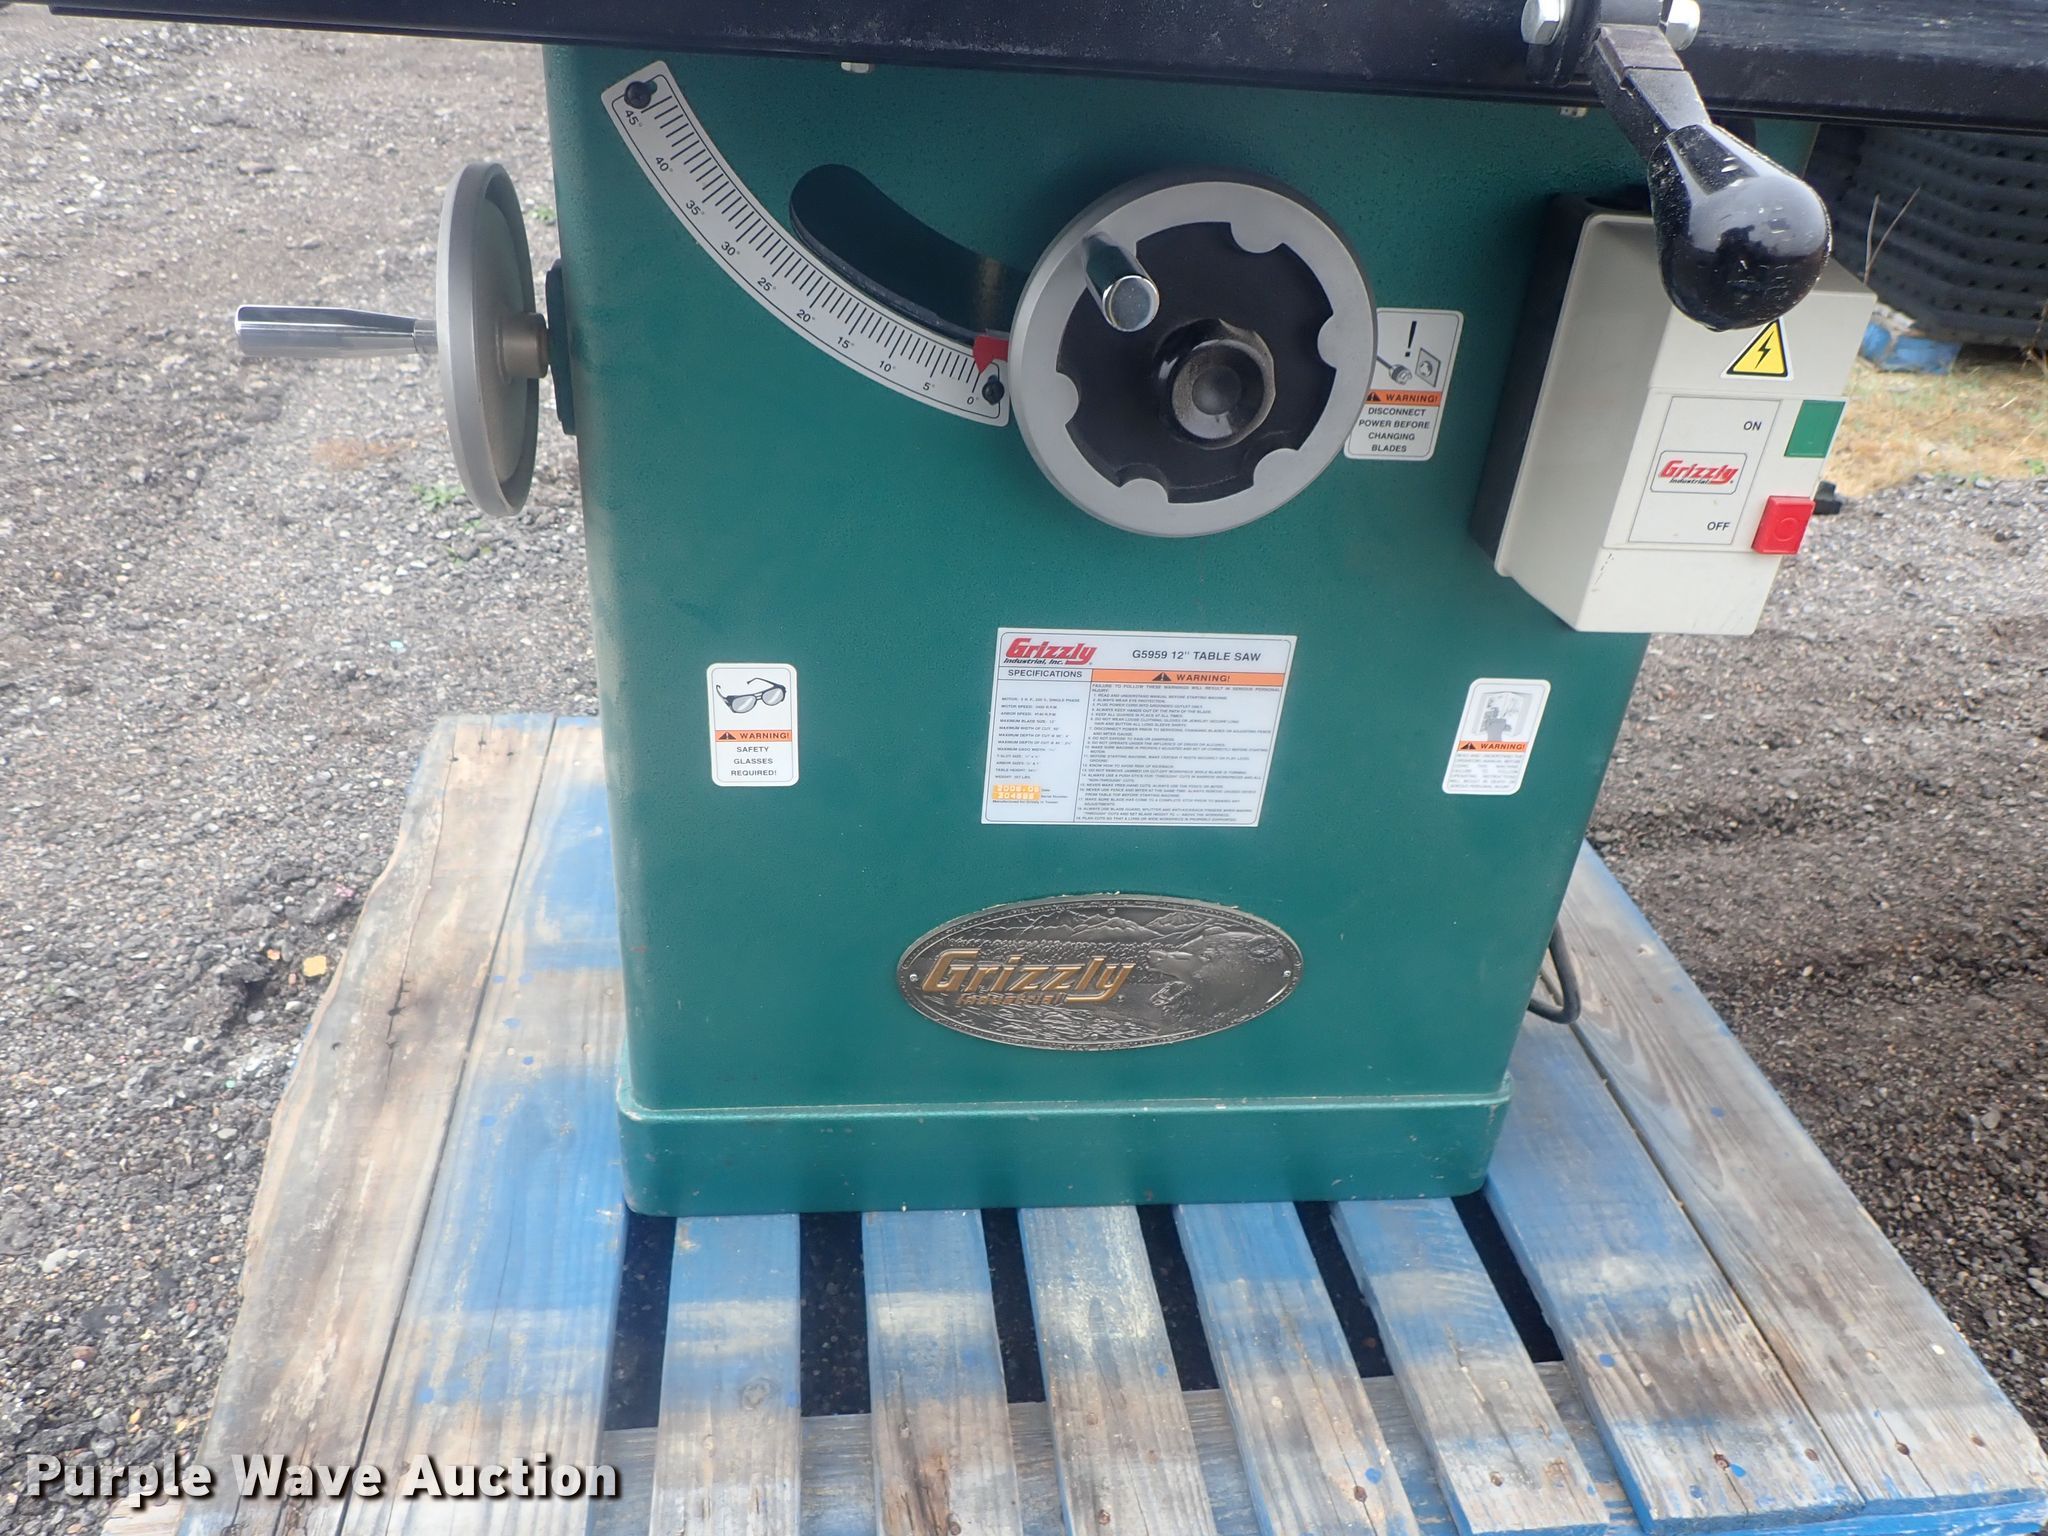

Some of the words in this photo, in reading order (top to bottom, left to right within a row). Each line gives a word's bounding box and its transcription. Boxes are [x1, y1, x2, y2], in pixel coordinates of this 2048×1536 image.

[1386, 393, 1439, 403] WARNING!
[1368, 407, 1426, 416] DISCONNECT
[1394, 421, 1430, 429] BEFORE
[1743, 420, 1762, 431] ON
[1368, 432, 1415, 441] CHANGING
[1658, 459, 1738, 485] Grizzly
[1707, 522, 1730, 531] OFF
[1006, 638, 1097, 665] Grizzly
[1132, 650, 1167, 659] G5959
[1193, 651, 1231, 661] TABLE
[1234, 652, 1262, 661] SAW
[1008, 669, 1083, 678] SPECIFICATIONS
[1176, 674, 1230, 682] WARNING!
[921, 948, 1136, 1003] Grizzly
